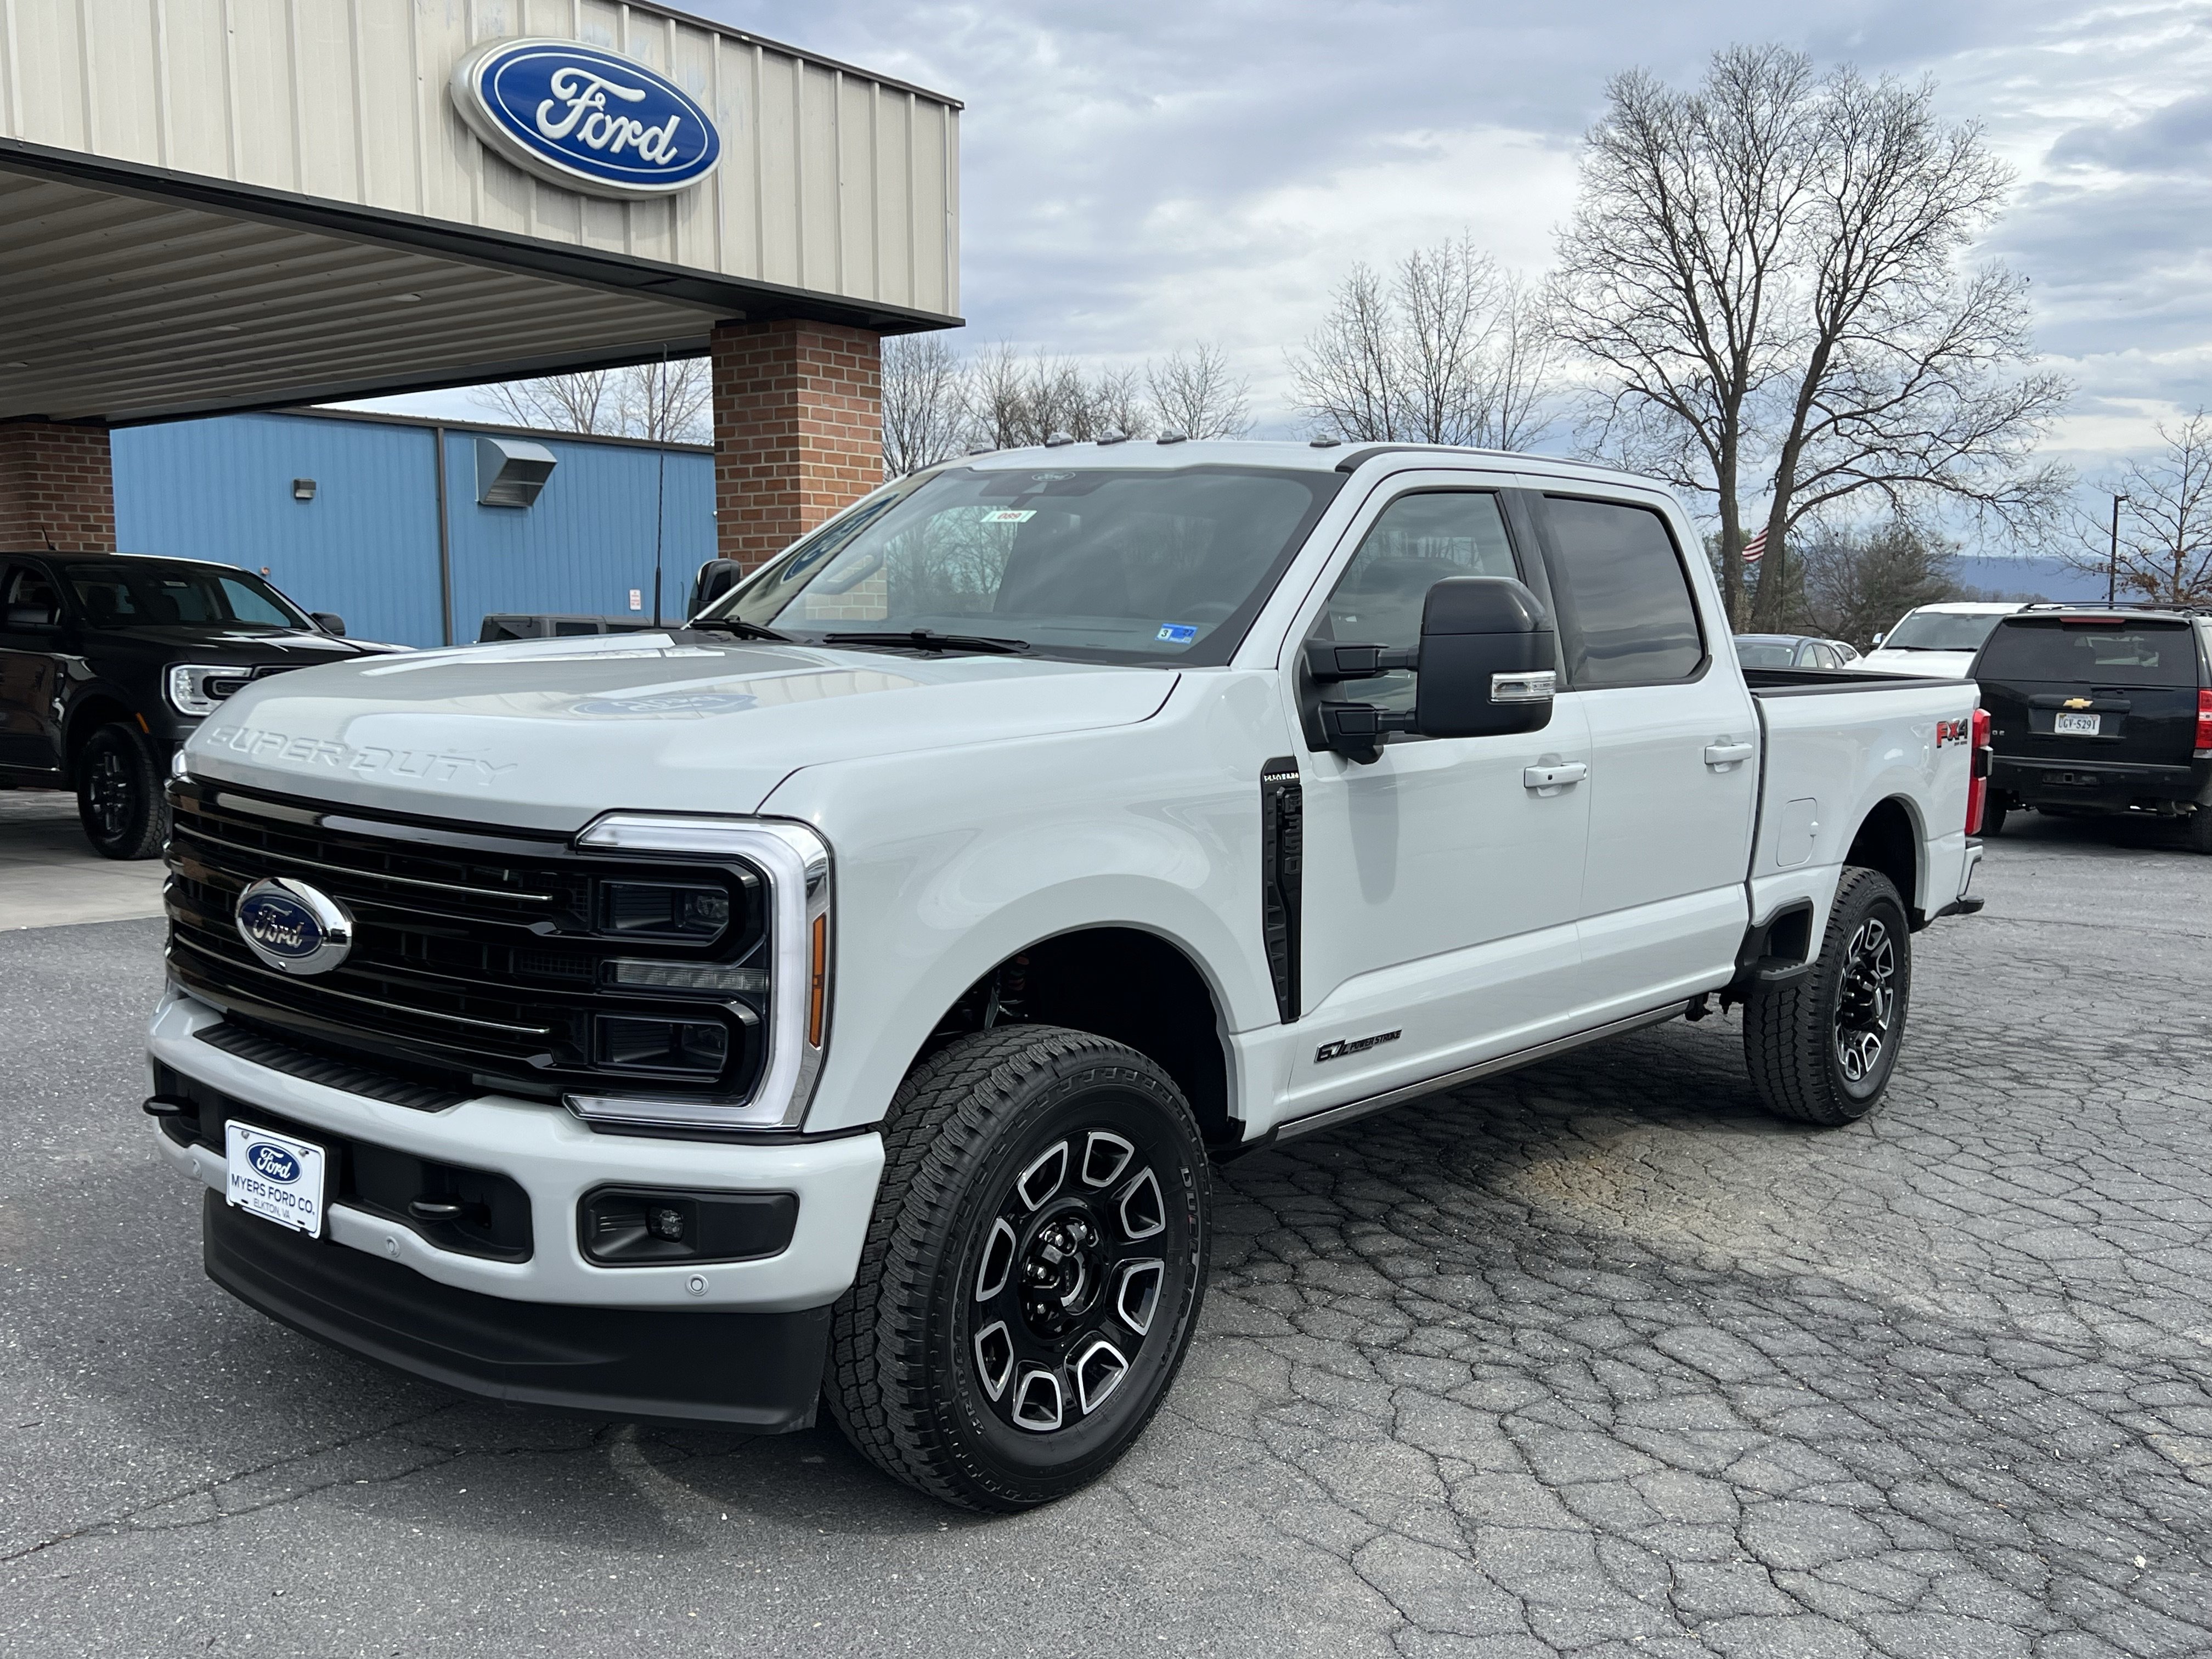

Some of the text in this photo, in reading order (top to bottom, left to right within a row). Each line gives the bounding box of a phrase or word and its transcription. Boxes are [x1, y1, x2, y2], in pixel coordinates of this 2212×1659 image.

[535, 67, 681, 166] Ford
[1937, 718, 1968, 748] FX4
[2058, 718, 2096, 730] UGV-5291
[206, 725, 518, 786] SUPER DUTY
[252, 903, 305, 949] Ford
[256, 1147, 292, 1179] Ford
[231, 1173, 315, 1216] MYERS FORD CO.
[253, 1198, 291, 1219] ELKTON, VA
